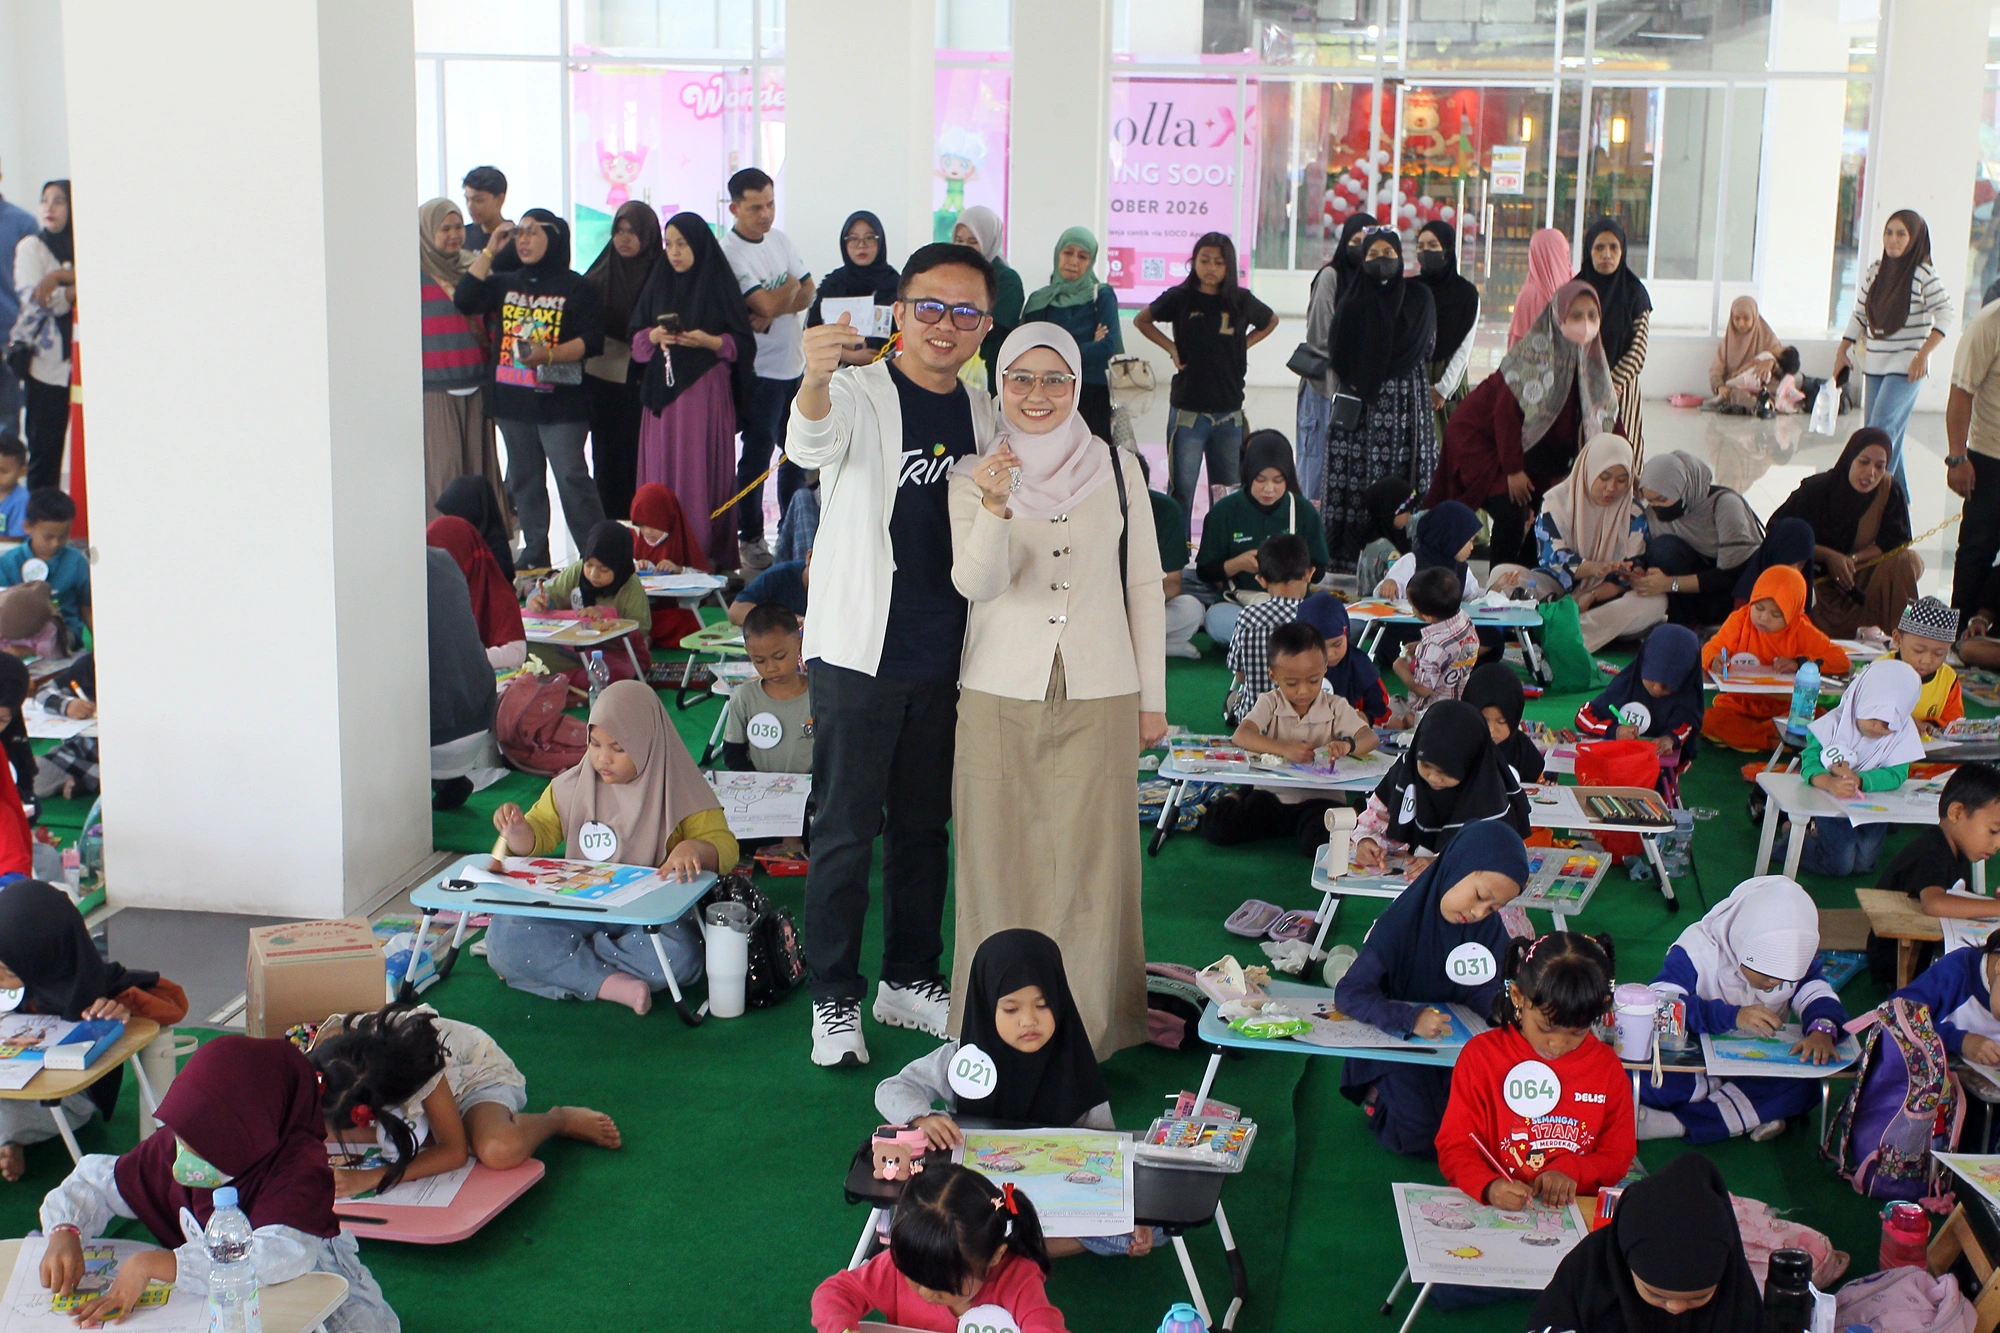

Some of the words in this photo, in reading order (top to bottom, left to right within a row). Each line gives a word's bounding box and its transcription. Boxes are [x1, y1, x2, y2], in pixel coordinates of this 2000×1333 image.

[1165, 201, 1209, 215] 2026
[502, 304, 563, 326] RELAX!
[1625, 711, 1645, 727] 131
[751, 722, 779, 739] 036
[1826, 747, 1845, 764] 06
[583, 832, 612, 849] 073
[1453, 957, 1489, 977] 031
[956, 1058, 992, 1087] 021
[1509, 1079, 1555, 1100] 064
[1531, 1115, 1579, 1127] SEMANGAT
[1531, 1123, 1579, 1141] 17AN
[1540, 1139, 1576, 1150] MERDEKA!
